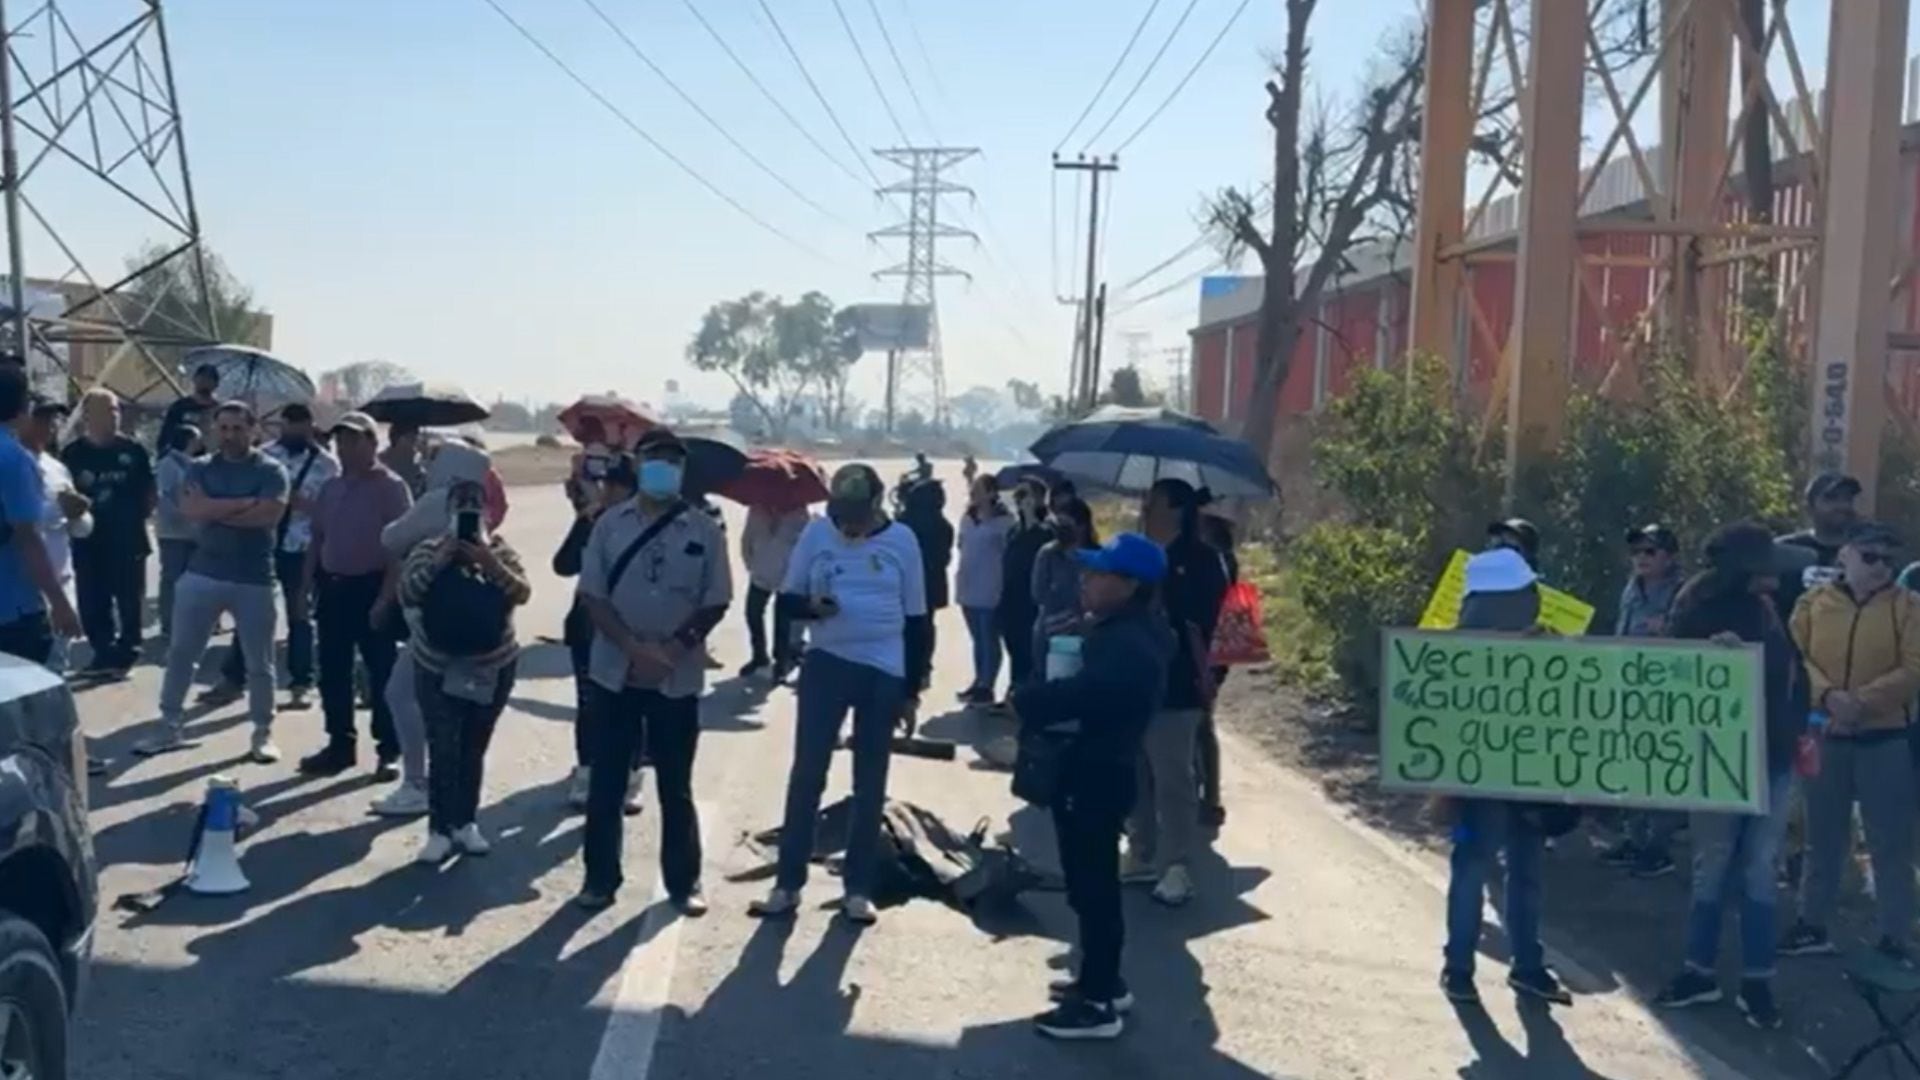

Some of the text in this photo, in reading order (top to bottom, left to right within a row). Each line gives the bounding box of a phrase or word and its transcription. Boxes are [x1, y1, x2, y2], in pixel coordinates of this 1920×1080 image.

[1395, 638, 1730, 690] Vecinos de la
[1419, 676, 1723, 729] Guadalupana
[1459, 719, 1684, 763] queremos
